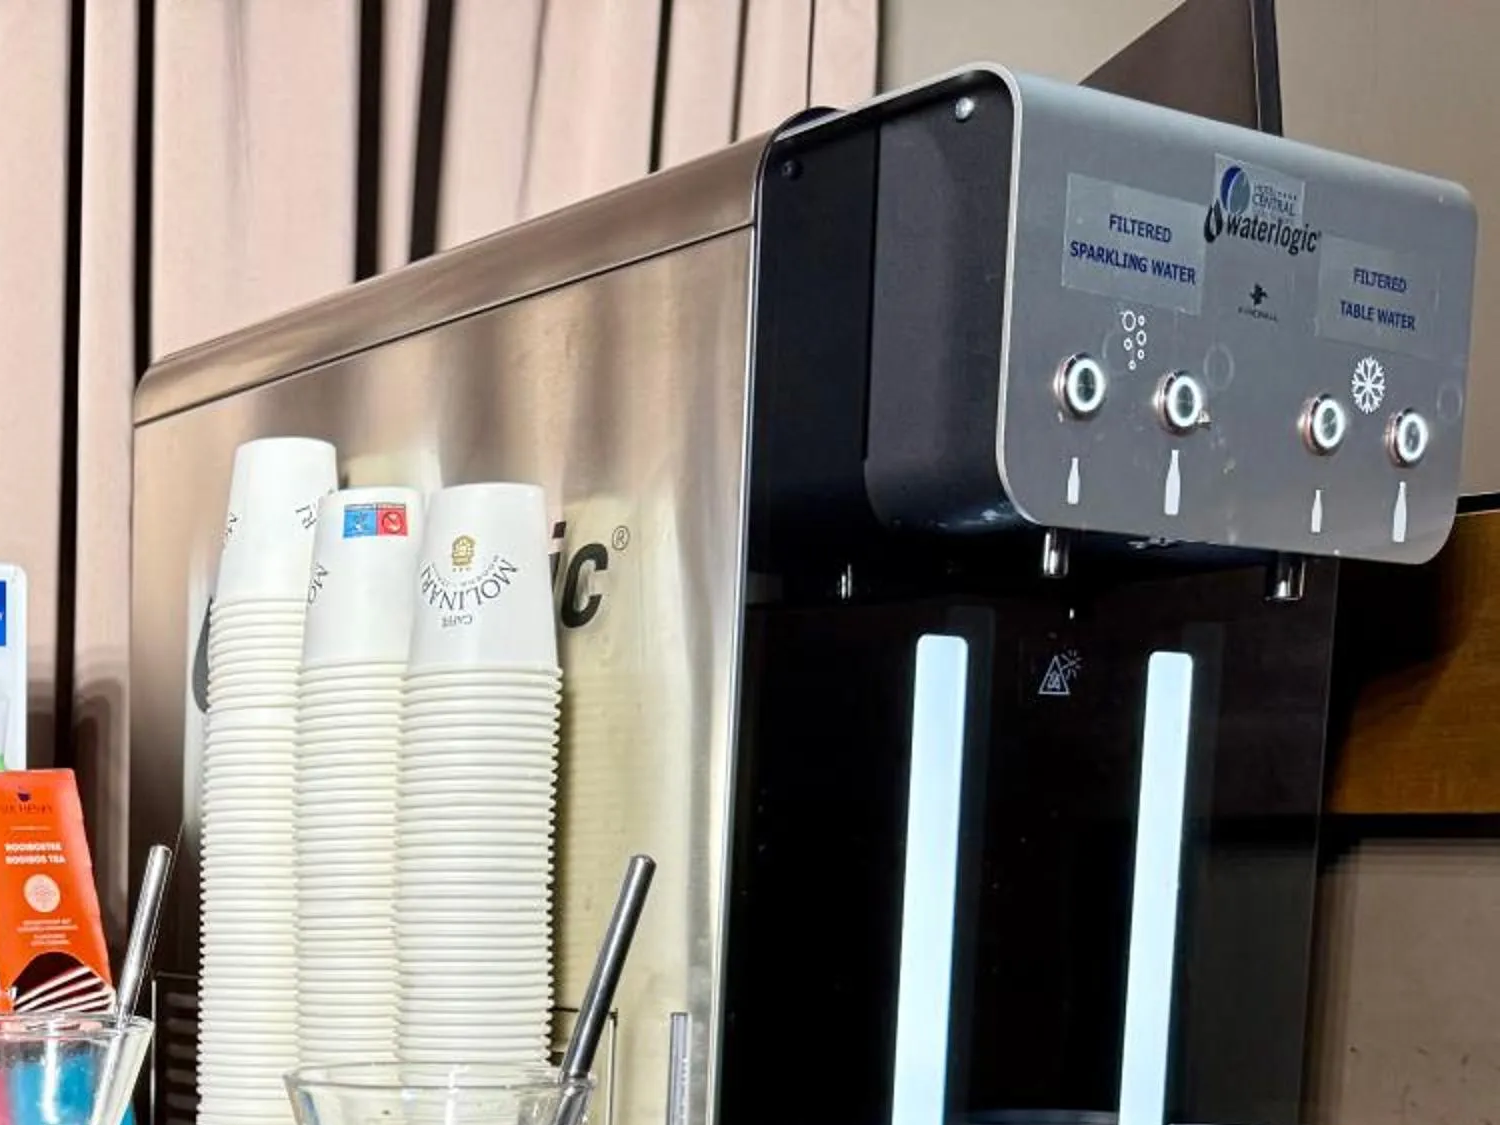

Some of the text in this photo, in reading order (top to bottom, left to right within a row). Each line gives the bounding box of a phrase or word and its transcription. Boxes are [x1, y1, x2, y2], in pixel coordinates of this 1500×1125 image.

[1108, 213, 1173, 243] FILTERED
[1070, 239, 1197, 285] SPARKLING WATER
[1353, 266, 1408, 294] FILTERED
[1340, 299, 1417, 331] TABLE WATER
